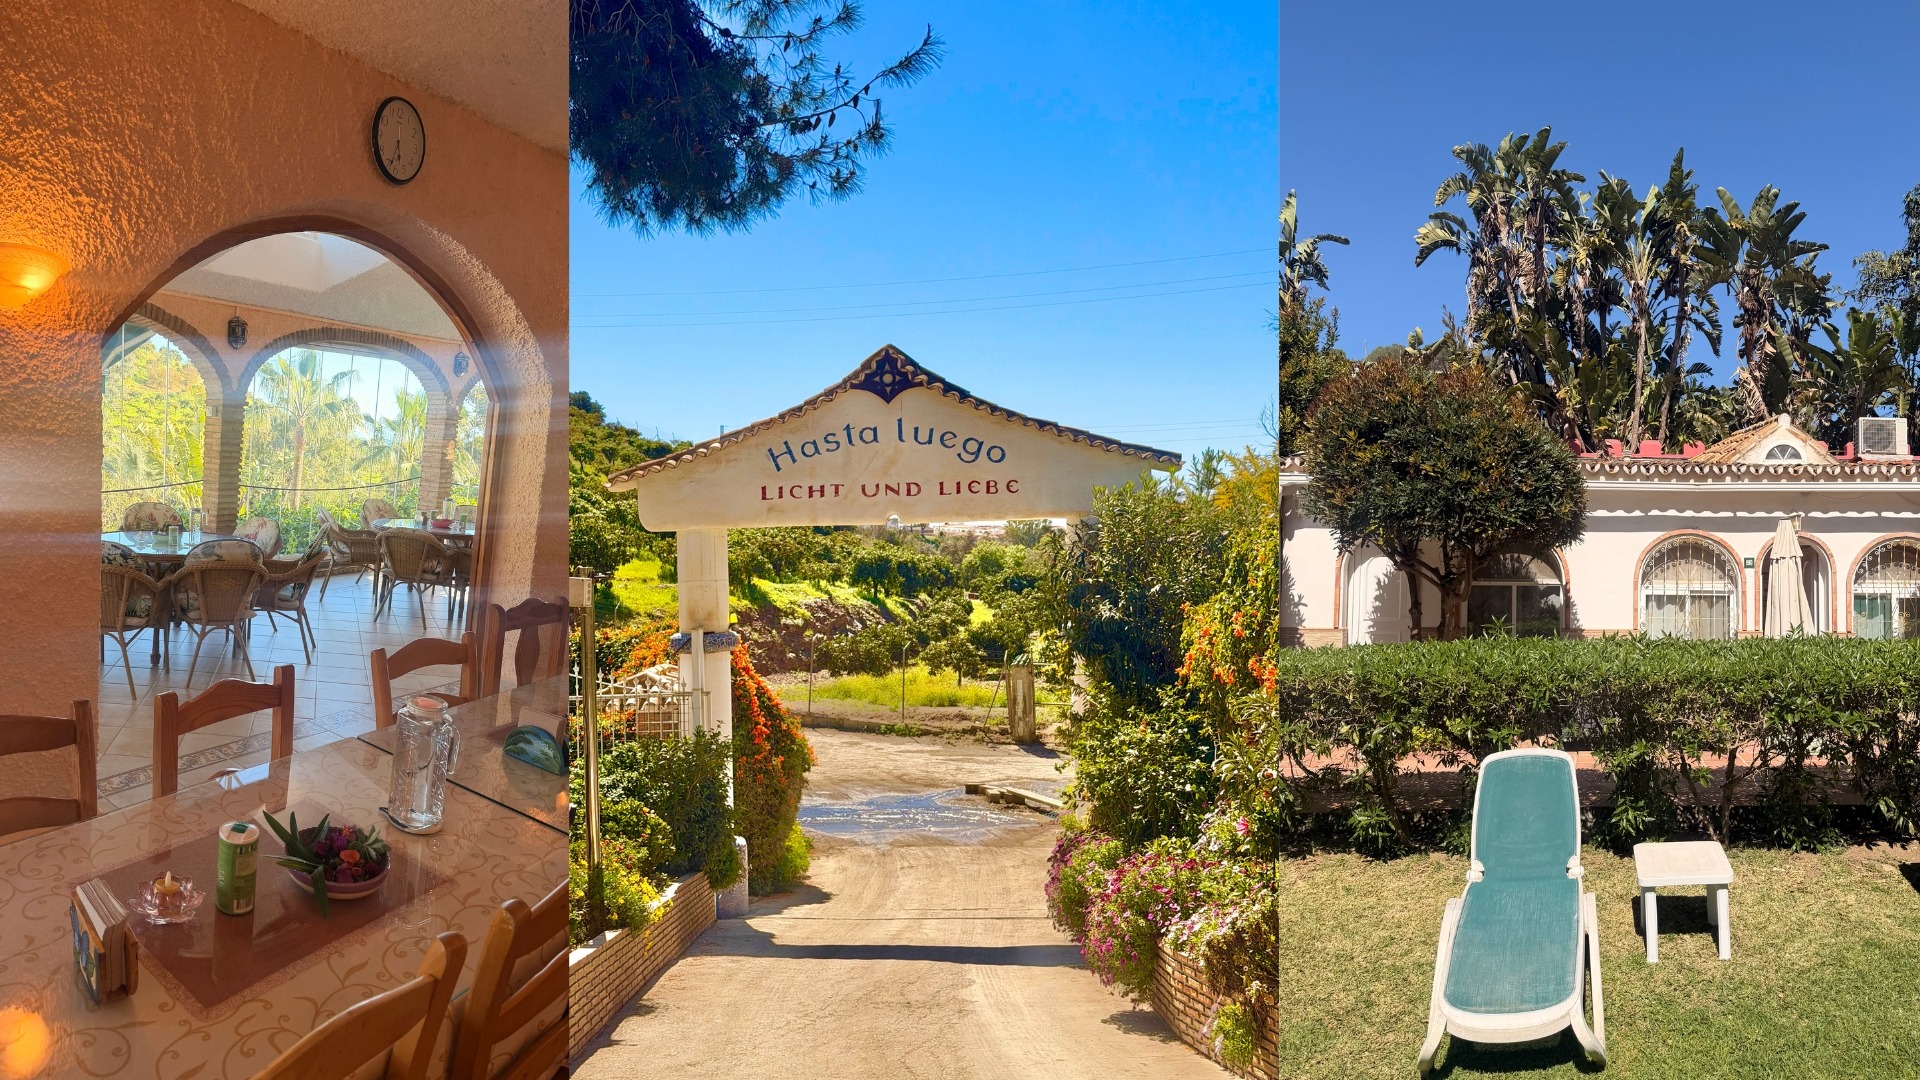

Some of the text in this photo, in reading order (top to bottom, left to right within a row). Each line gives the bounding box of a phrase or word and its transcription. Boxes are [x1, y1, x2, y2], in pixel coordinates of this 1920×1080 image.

[397, 107, 404, 119] 12
[412, 127, 417, 139] 2
[413, 144, 418, 155] 3
[408, 157, 413, 168] 4
[393, 166, 398, 176] 6
[402, 165, 407, 175] 5
[767, 417, 1006, 473] Hasta luego
[760, 479, 1020, 501] LICHT UND LIEBE
